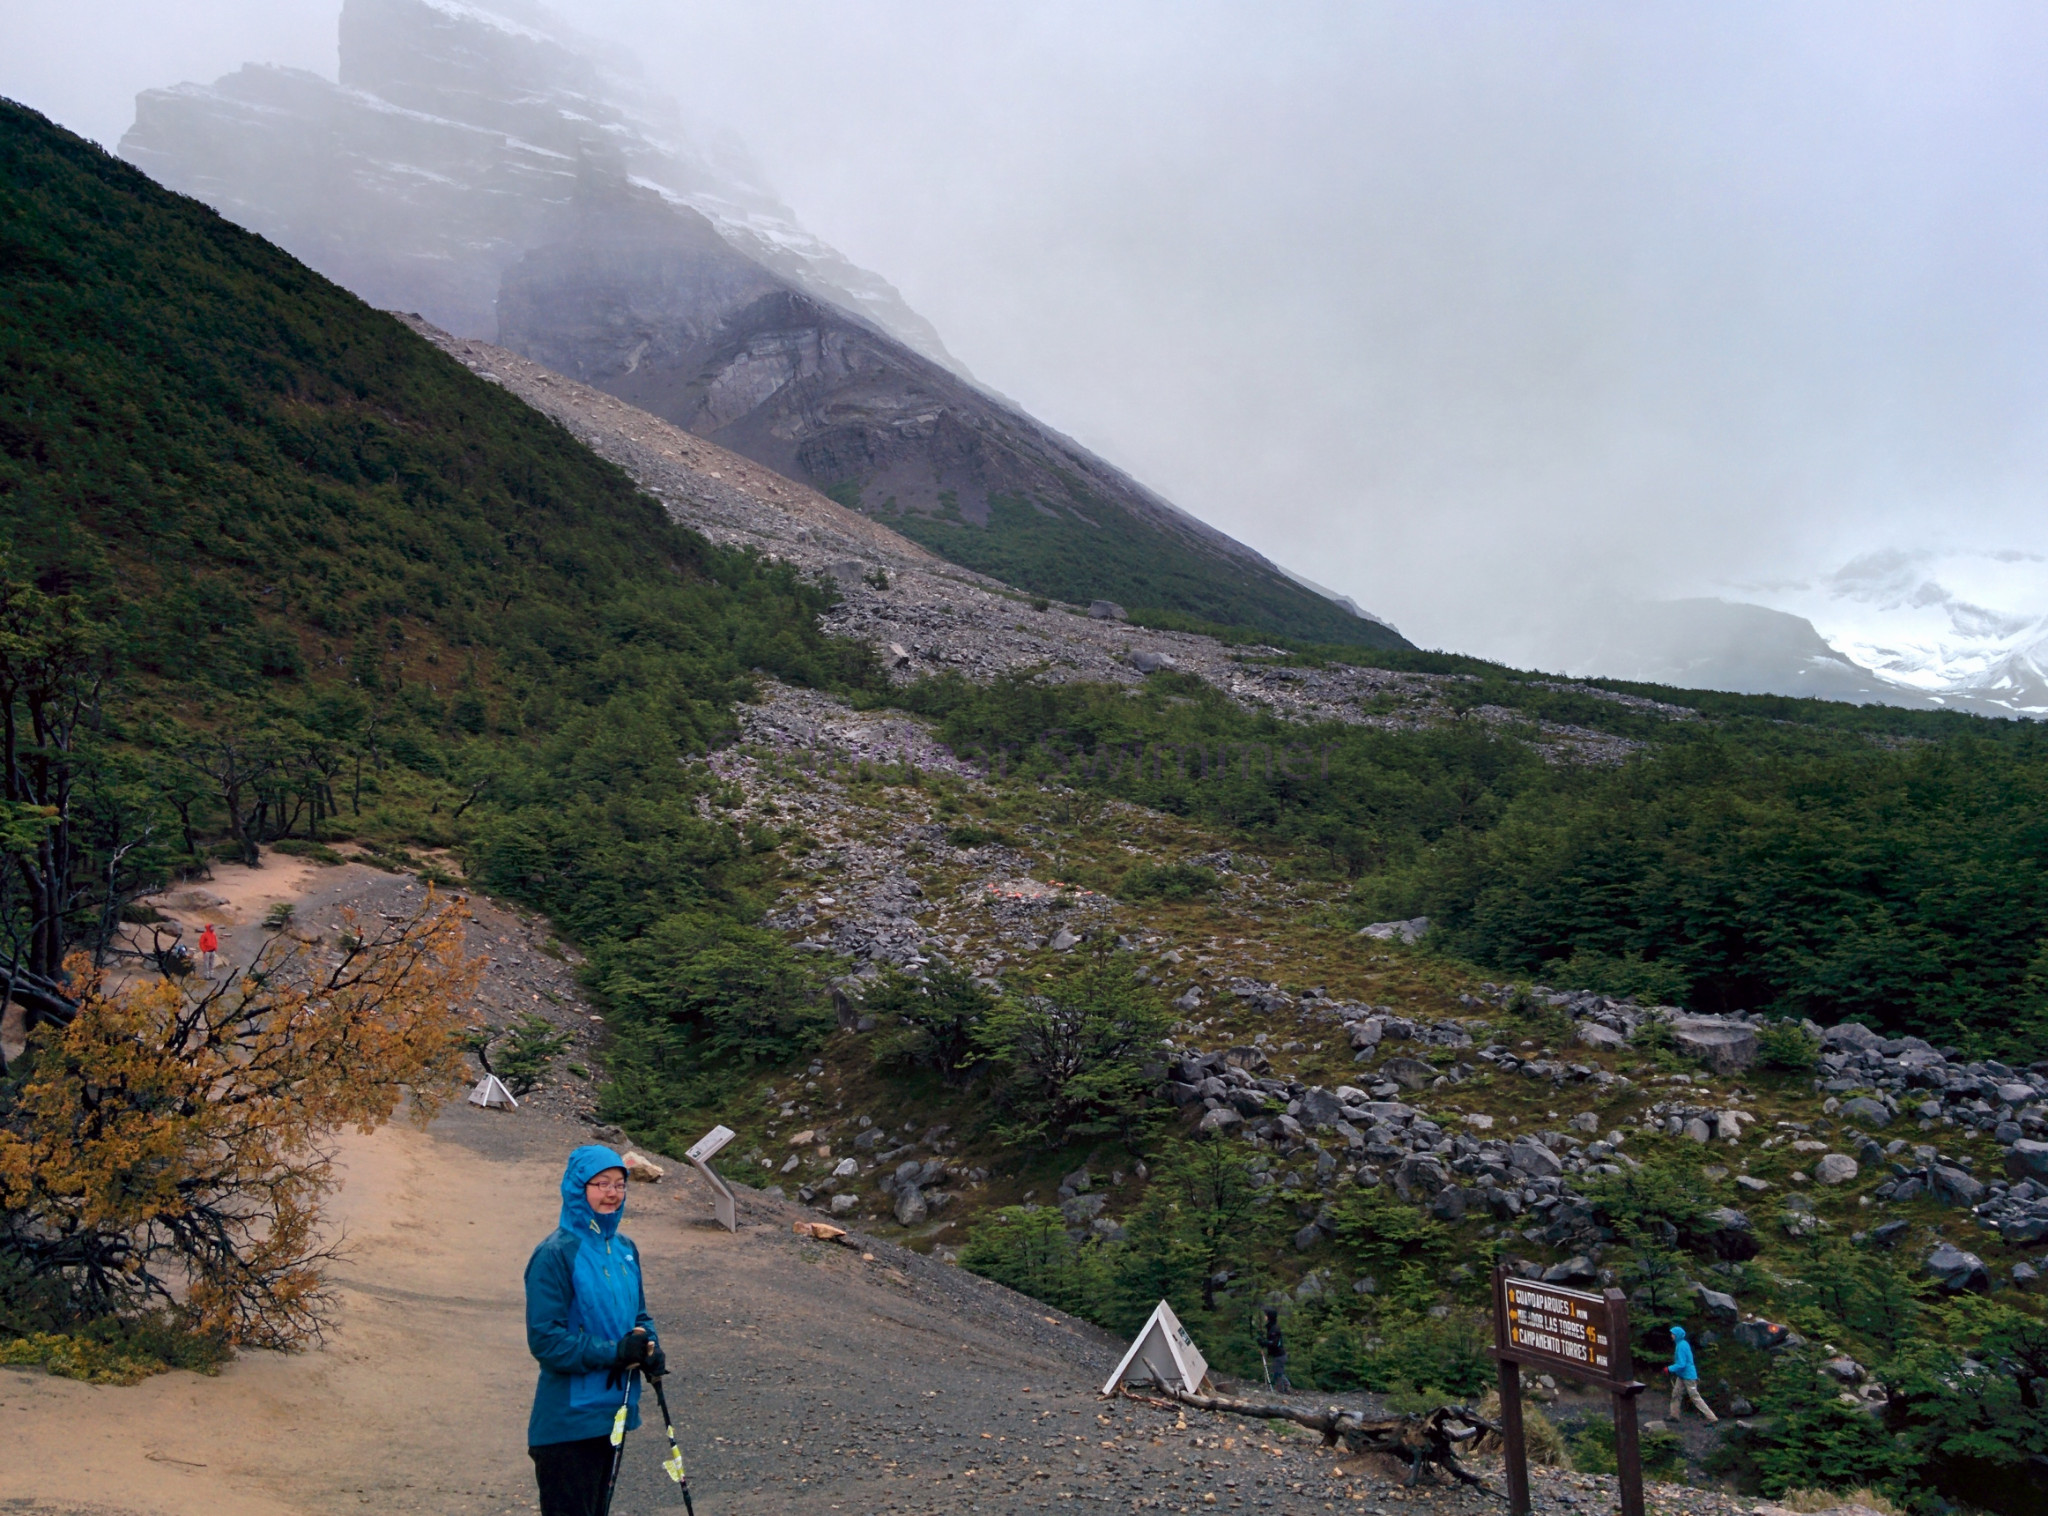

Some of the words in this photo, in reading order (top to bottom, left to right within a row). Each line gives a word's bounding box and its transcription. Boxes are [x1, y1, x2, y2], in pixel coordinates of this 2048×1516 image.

[1570, 1302, 1576, 1316] 1
[1545, 1317, 1557, 1333] LAS
[1559, 1319, 1585, 1340] TORRES
[1586, 1326, 1596, 1343] 45
[1519, 1329, 1560, 1353] CAMPAMENTO
[1561, 1340, 1587, 1361] TORRES
[1589, 1348, 1595, 1363] 1
